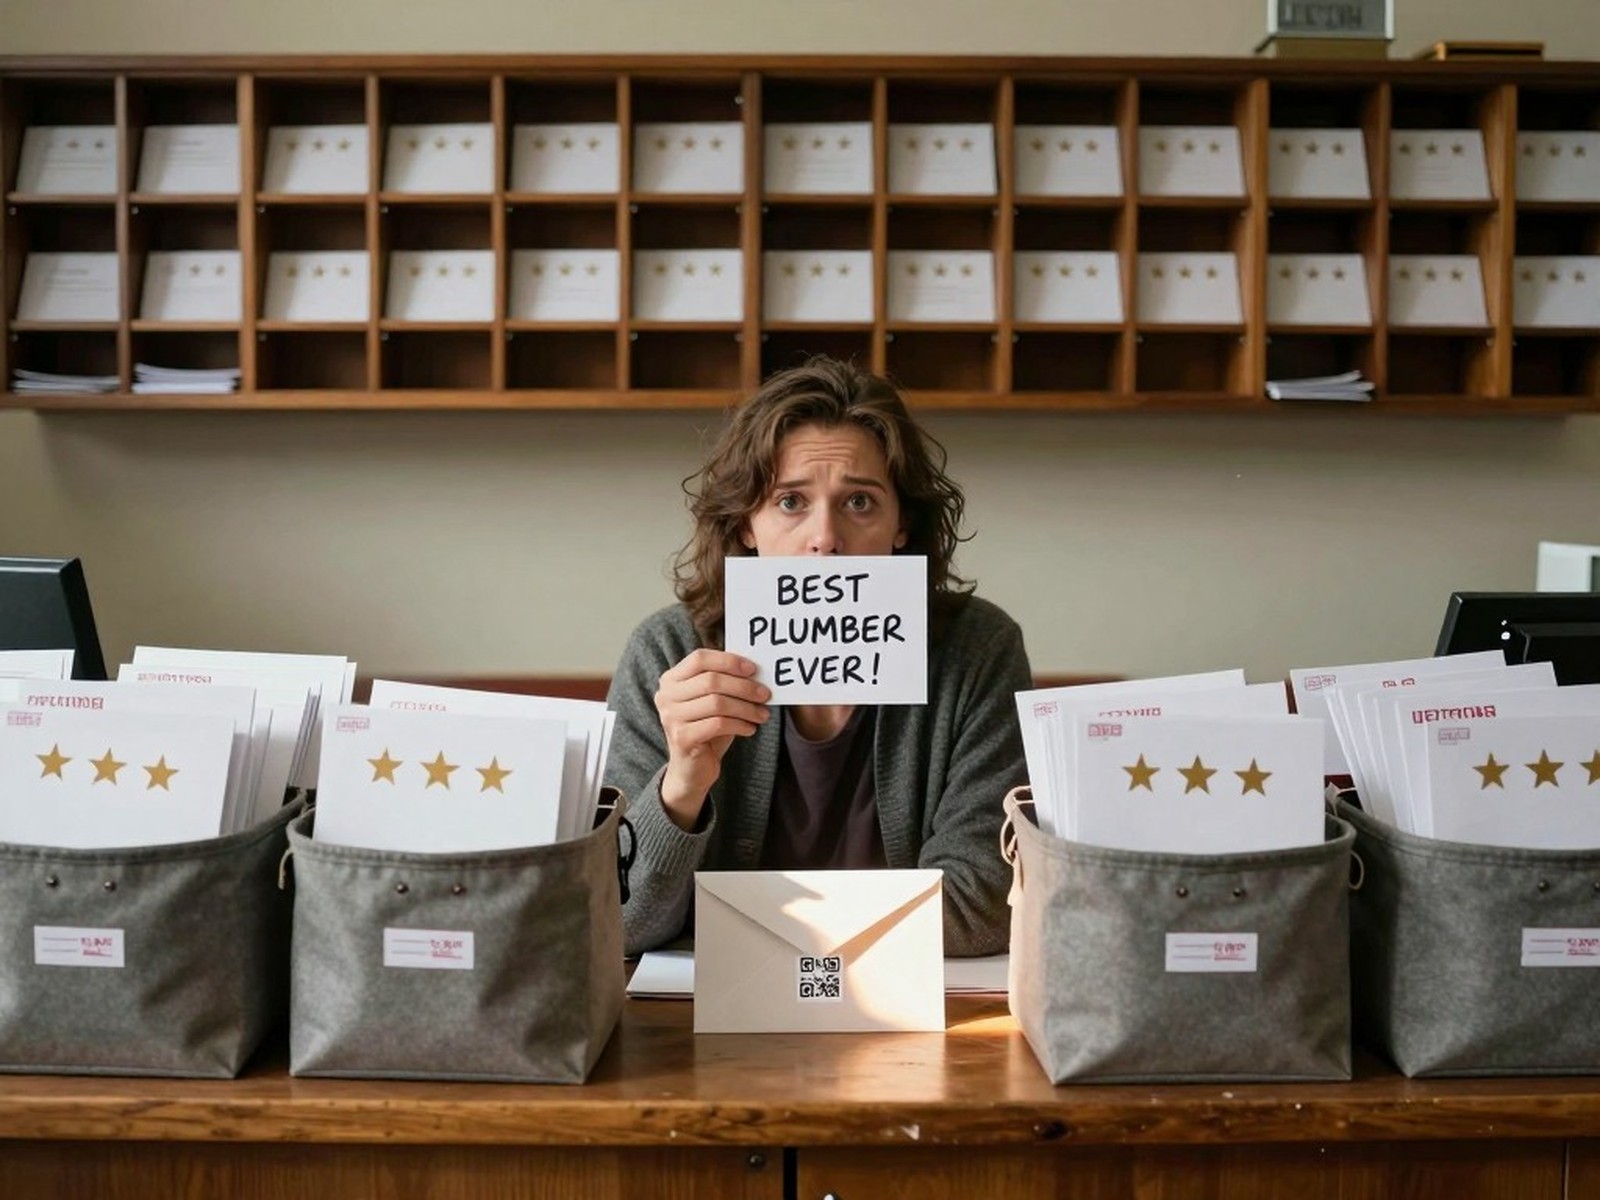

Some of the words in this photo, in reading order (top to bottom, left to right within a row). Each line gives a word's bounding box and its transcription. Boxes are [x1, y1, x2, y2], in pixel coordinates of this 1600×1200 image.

[777, 573, 870, 606] BEST
[749, 613, 906, 647] PLUMBER
[774, 652, 880, 687] EVER!
